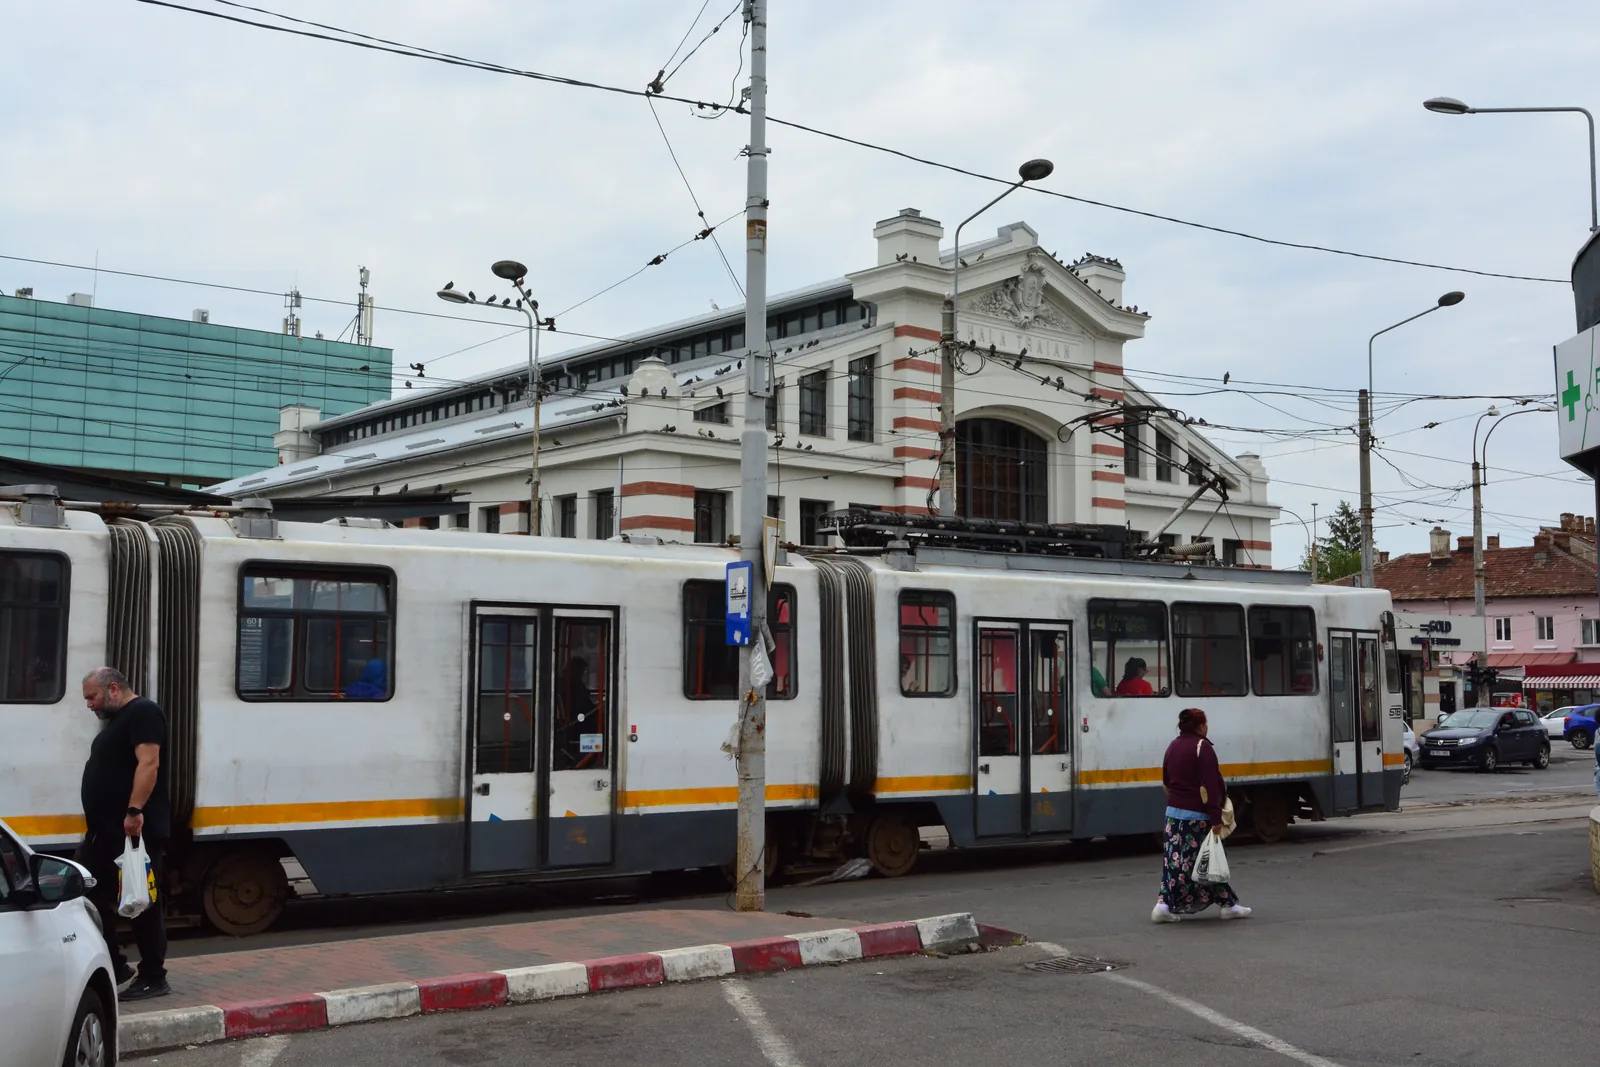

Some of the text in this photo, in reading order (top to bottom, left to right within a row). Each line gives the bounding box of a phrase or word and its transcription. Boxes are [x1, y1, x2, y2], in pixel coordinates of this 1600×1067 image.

[968, 324, 1070, 359] HALA TRAIAN
[1389, 707, 1402, 717] STB
